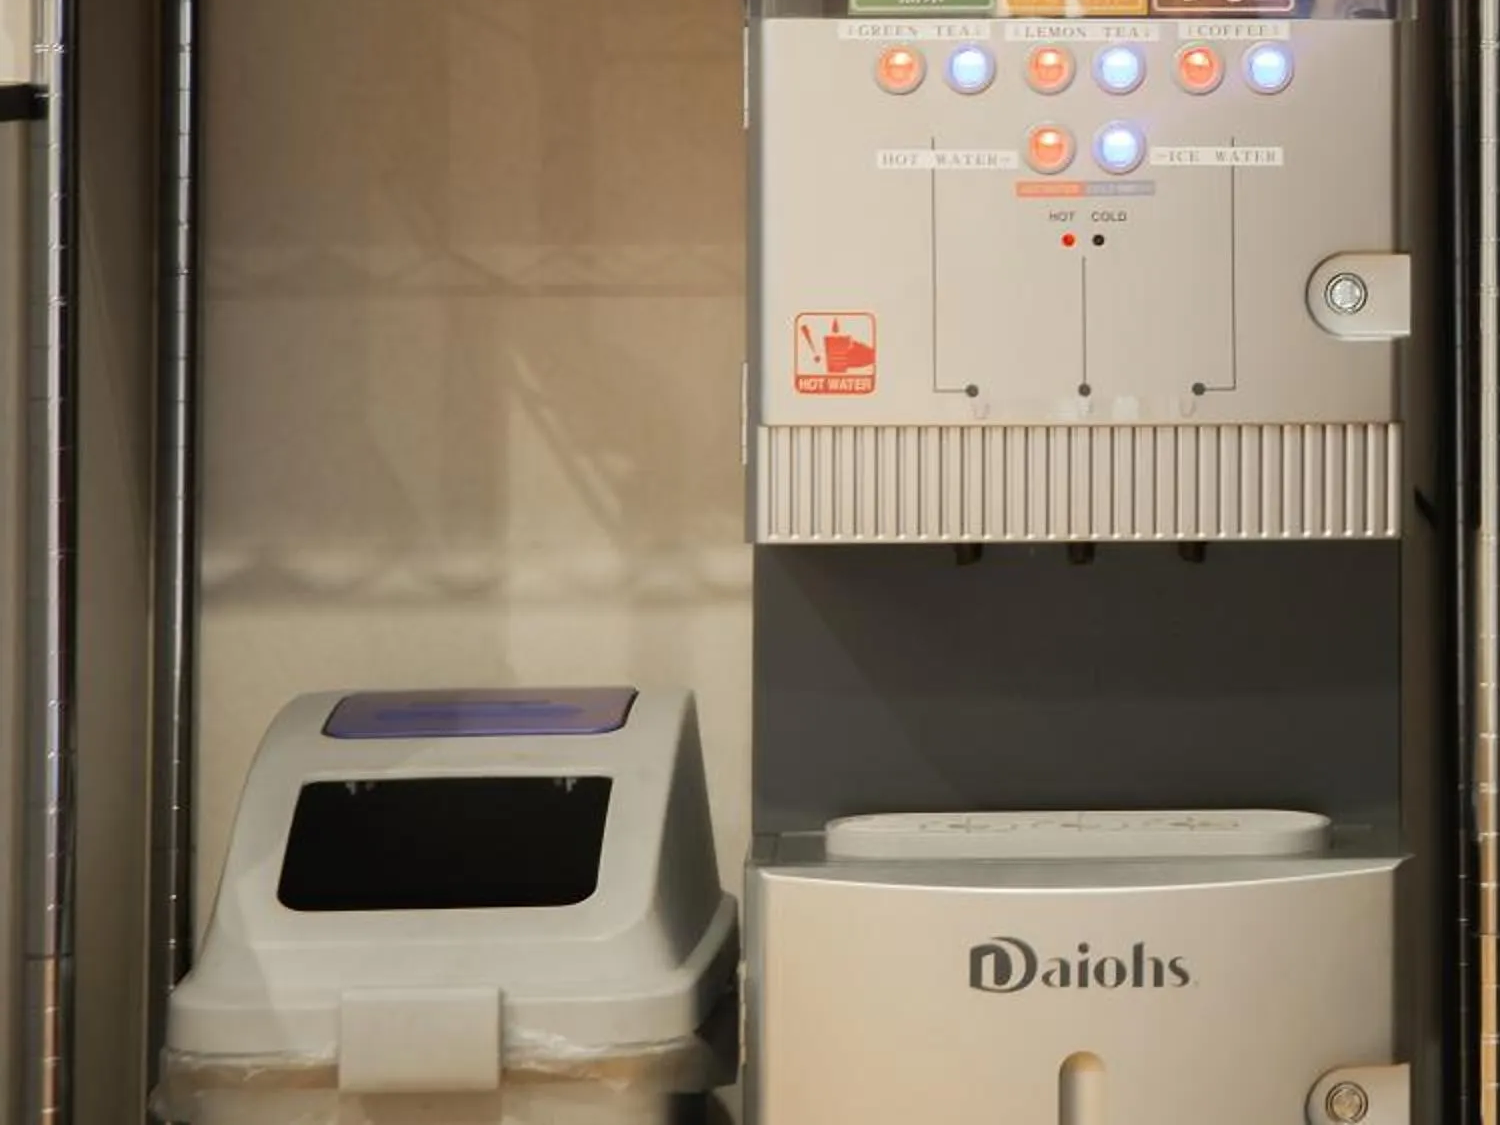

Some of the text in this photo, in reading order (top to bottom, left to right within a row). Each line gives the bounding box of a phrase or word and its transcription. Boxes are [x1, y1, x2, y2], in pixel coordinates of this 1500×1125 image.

[858, 24, 971, 37] GREEN TEA
[1024, 26, 1139, 38] LEMON TEA
[1196, 24, 1267, 37] COFFEE
[881, 153, 998, 166] HOT WATER
[1168, 150, 1277, 163] ICE WATER
[1049, 210, 1128, 222] HOT COLD
[799, 378, 872, 390] HOT WATER
[969, 936, 1190, 993] Daiohs
